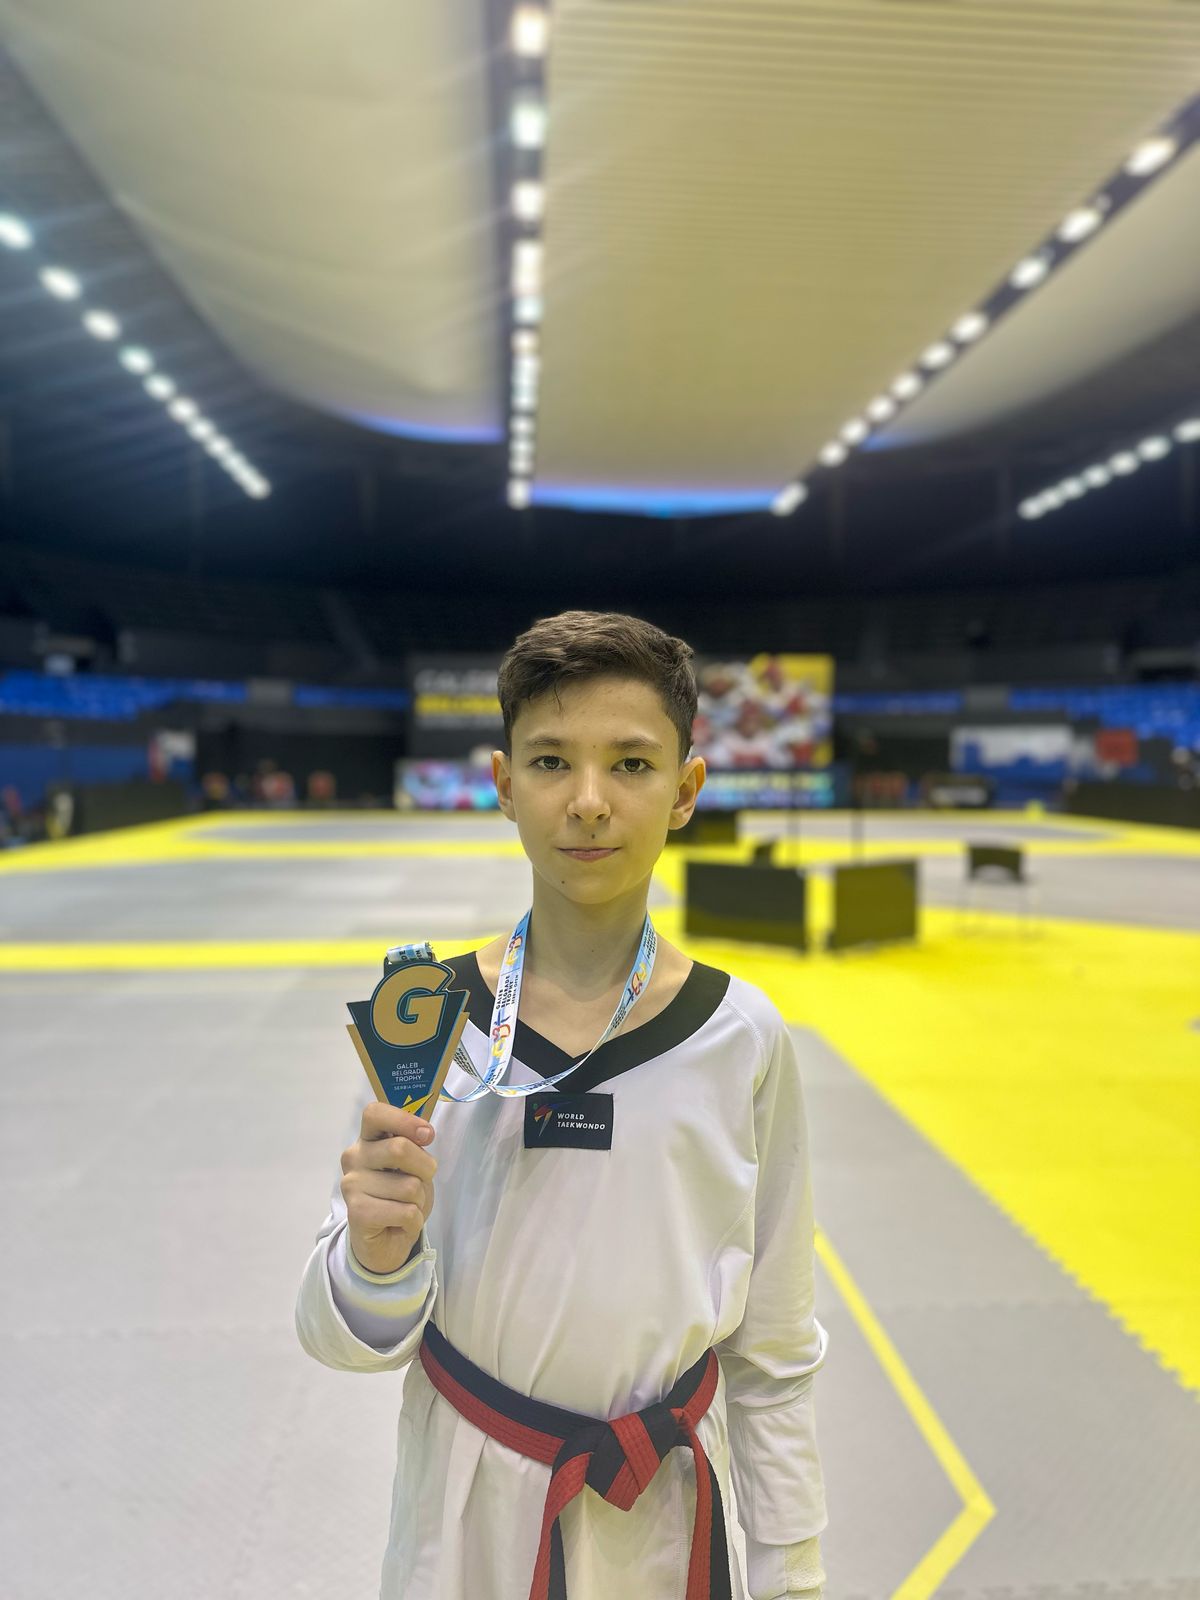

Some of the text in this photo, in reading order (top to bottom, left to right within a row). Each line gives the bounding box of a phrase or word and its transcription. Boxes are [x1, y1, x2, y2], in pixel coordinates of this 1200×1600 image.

[371, 963, 451, 1048] G
[396, 1062, 419, 1070] GALEB
[391, 1067, 425, 1077] BELGRADE
[395, 1074, 422, 1082] TROPHY
[557, 1112, 585, 1120] WORLD
[557, 1121, 606, 1130] TAEKWONDO
